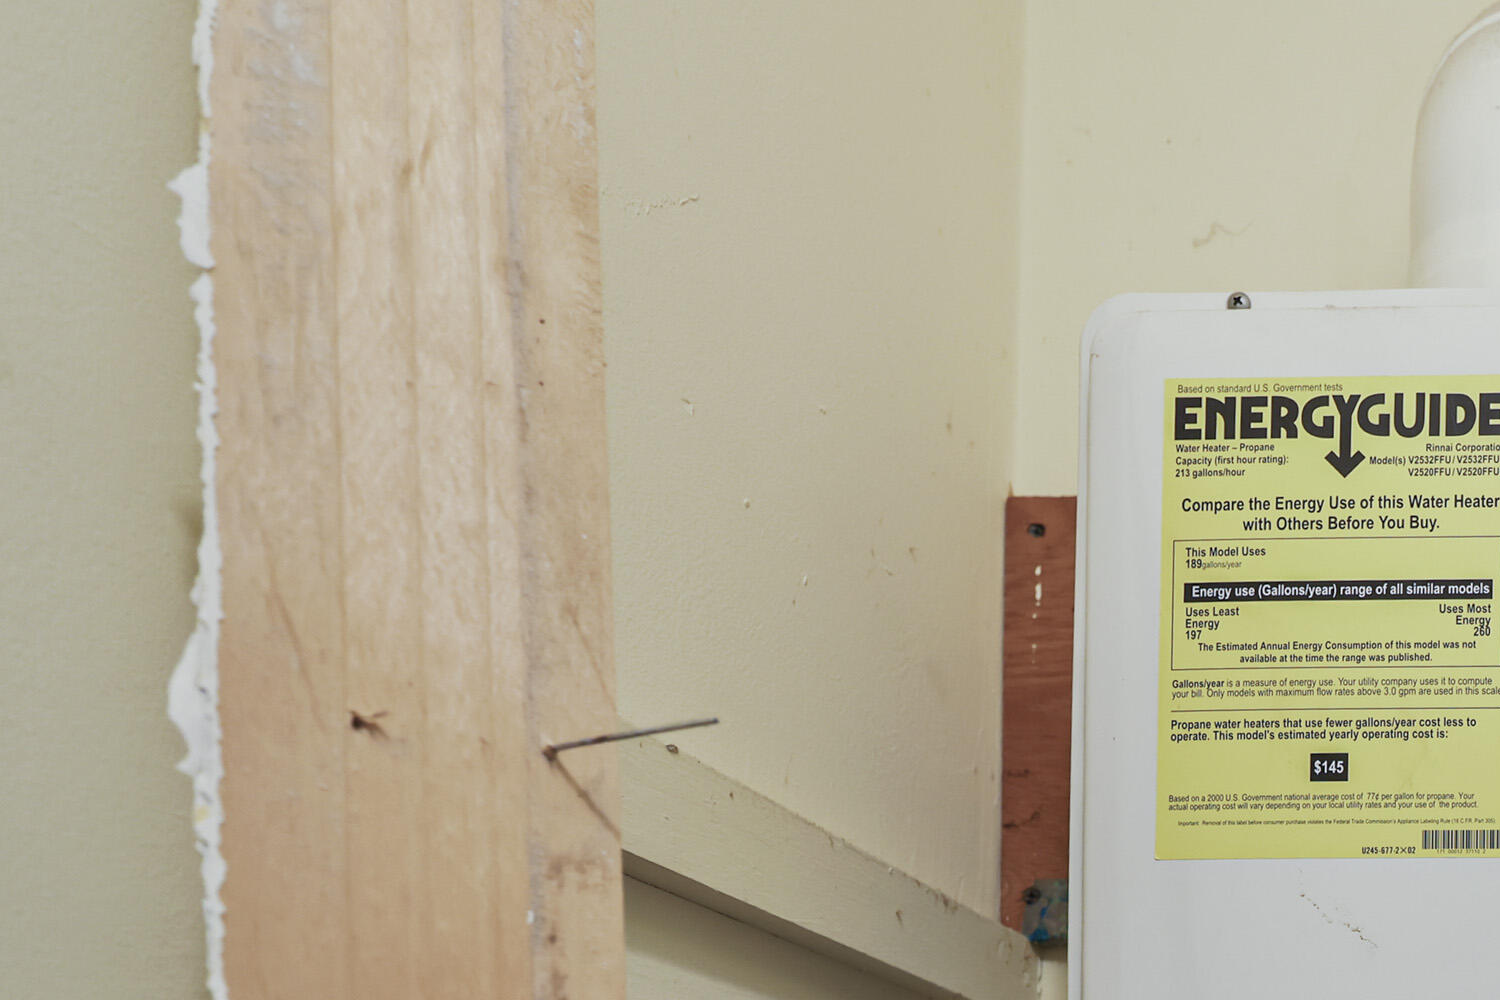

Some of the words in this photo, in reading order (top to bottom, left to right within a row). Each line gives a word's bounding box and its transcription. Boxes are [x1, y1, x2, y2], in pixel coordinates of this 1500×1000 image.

[1177, 383, 1203, 394] Based
[1204, 385, 1215, 393] on
[1216, 384, 1251, 393] standard
[1272, 382, 1322, 392] Government
[1323, 383, 1343, 391] tests
[1175, 443, 1200, 452] Water
[1202, 443, 1230, 452] Heater
[1239, 442, 1274, 453] Propane
[1425, 442, 1453, 452] Rinnai
[1175, 455, 1212, 467] Capacity
[1214, 455, 1234, 466] (first
[1236, 455, 1256, 464] hour
[1258, 454, 1288, 466] rating):
[1369, 455, 1406, 466] Model(s)
[1175, 468, 1190, 477] 213
[1191, 467, 1245, 479] gallons/hour
[1181, 497, 1244, 514] Compare
[1248, 496, 1270, 510] the
[1275, 495, 1324, 513] Energy
[1329, 495, 1355, 509] Use
[1359, 495, 1374, 509] of
[1377, 494, 1404, 509] this
[1408, 494, 1450, 508] Water
[1454, 494, 1500, 508] Heater
[1242, 516, 1271, 531] with
[1276, 516, 1323, 530] Others
[1328, 515, 1374, 530] Before
[1378, 514, 1404, 529] You
[1409, 514, 1439, 531] Buy.
[1185, 546, 1206, 557] This
[1209, 546, 1238, 557] Model
[1241, 546, 1266, 556] Uses
[1192, 585, 1232, 600] Energy
[1234, 587, 1255, 596] use
[1258, 583, 1336, 599] (Gallons/year)
[1339, 585, 1372, 598] range
[1375, 582, 1387, 594] of
[1389, 582, 1403, 595] all
[1406, 581, 1445, 595] similar
[1448, 582, 1490, 594] models
[1185, 606, 1209, 617] Uses
[1212, 606, 1239, 616] Least
[1438, 603, 1464, 614] Uses
[1466, 603, 1491, 614] Most
[1185, 618, 1220, 631] Energy
[1455, 615, 1491, 628] Energy
[1185, 629, 1202, 640] 197
[1473, 626, 1490, 636] 260
[1197, 642, 1214, 651] The
[1215, 641, 1258, 651] Estimated
[1259, 641, 1290, 650] Annual
[1292, 640, 1323, 652] Energy
[1324, 640, 1382, 651] Consumption
[1384, 640, 1393, 649] of
[1395, 640, 1411, 649] this
[1413, 639, 1440, 649] model
[1442, 641, 1460, 649] was
[1461, 640, 1476, 648] not
[1239, 653, 1277, 663] available
[1279, 654, 1287, 662] at
[1289, 653, 1303, 662] the
[1305, 653, 1324, 662] time
[1325, 653, 1339, 662] the
[1341, 654, 1366, 664] range
[1368, 654, 1385, 662] was
[1387, 652, 1432, 663] published.
[1171, 678, 1224, 690] Gallons/year
[1226, 679, 1233, 687] is
[1242, 679, 1277, 689] measure
[1278, 677, 1287, 687] of
[1288, 679, 1316, 688] energy
[1317, 679, 1335, 688] use.
[1338, 677, 1356, 686] Your
[1358, 677, 1379, 688] utility
[1380, 678, 1417, 688] company
[1440, 677, 1446, 685] it
[1448, 676, 1456, 687] to
[1457, 676, 1492, 687] compute
[1171, 690, 1189, 699] your
[1206, 688, 1225, 699] Only
[1226, 687, 1255, 697] models
[1257, 687, 1273, 696] with
[1275, 687, 1314, 696] maximum
[1316, 687, 1333, 696] flow
[1334, 687, 1355, 696] rates
[1356, 687, 1381, 696] above
[1383, 687, 1396, 696] 3.0
[1398, 688, 1416, 697] gpm
[1418, 687, 1431, 695] are
[1433, 686, 1453, 695] used
[1464, 686, 1479, 695] this
[1170, 719, 1211, 732] Propane
[1213, 719, 1241, 731] water
[1243, 718, 1280, 731] heaters
[1282, 717, 1302, 731] that
[1304, 719, 1323, 731] use
[1323, 717, 1353, 730] fewer
[1355, 716, 1416, 730] gallons/year
[1418, 717, 1440, 730] cost
[1443, 716, 1463, 727] less
[1466, 717, 1476, 727] to
[1170, 729, 1210, 743] operate.
[1212, 730, 1233, 740] This
[1236, 729, 1275, 740] model's
[1277, 729, 1326, 740] estimated
[1328, 728, 1360, 742] yearly
[1361, 728, 1409, 741] operating
[1411, 729, 1433, 738] cost
[1436, 728, 1448, 738] is:
[1314, 759, 1344, 775] $145
